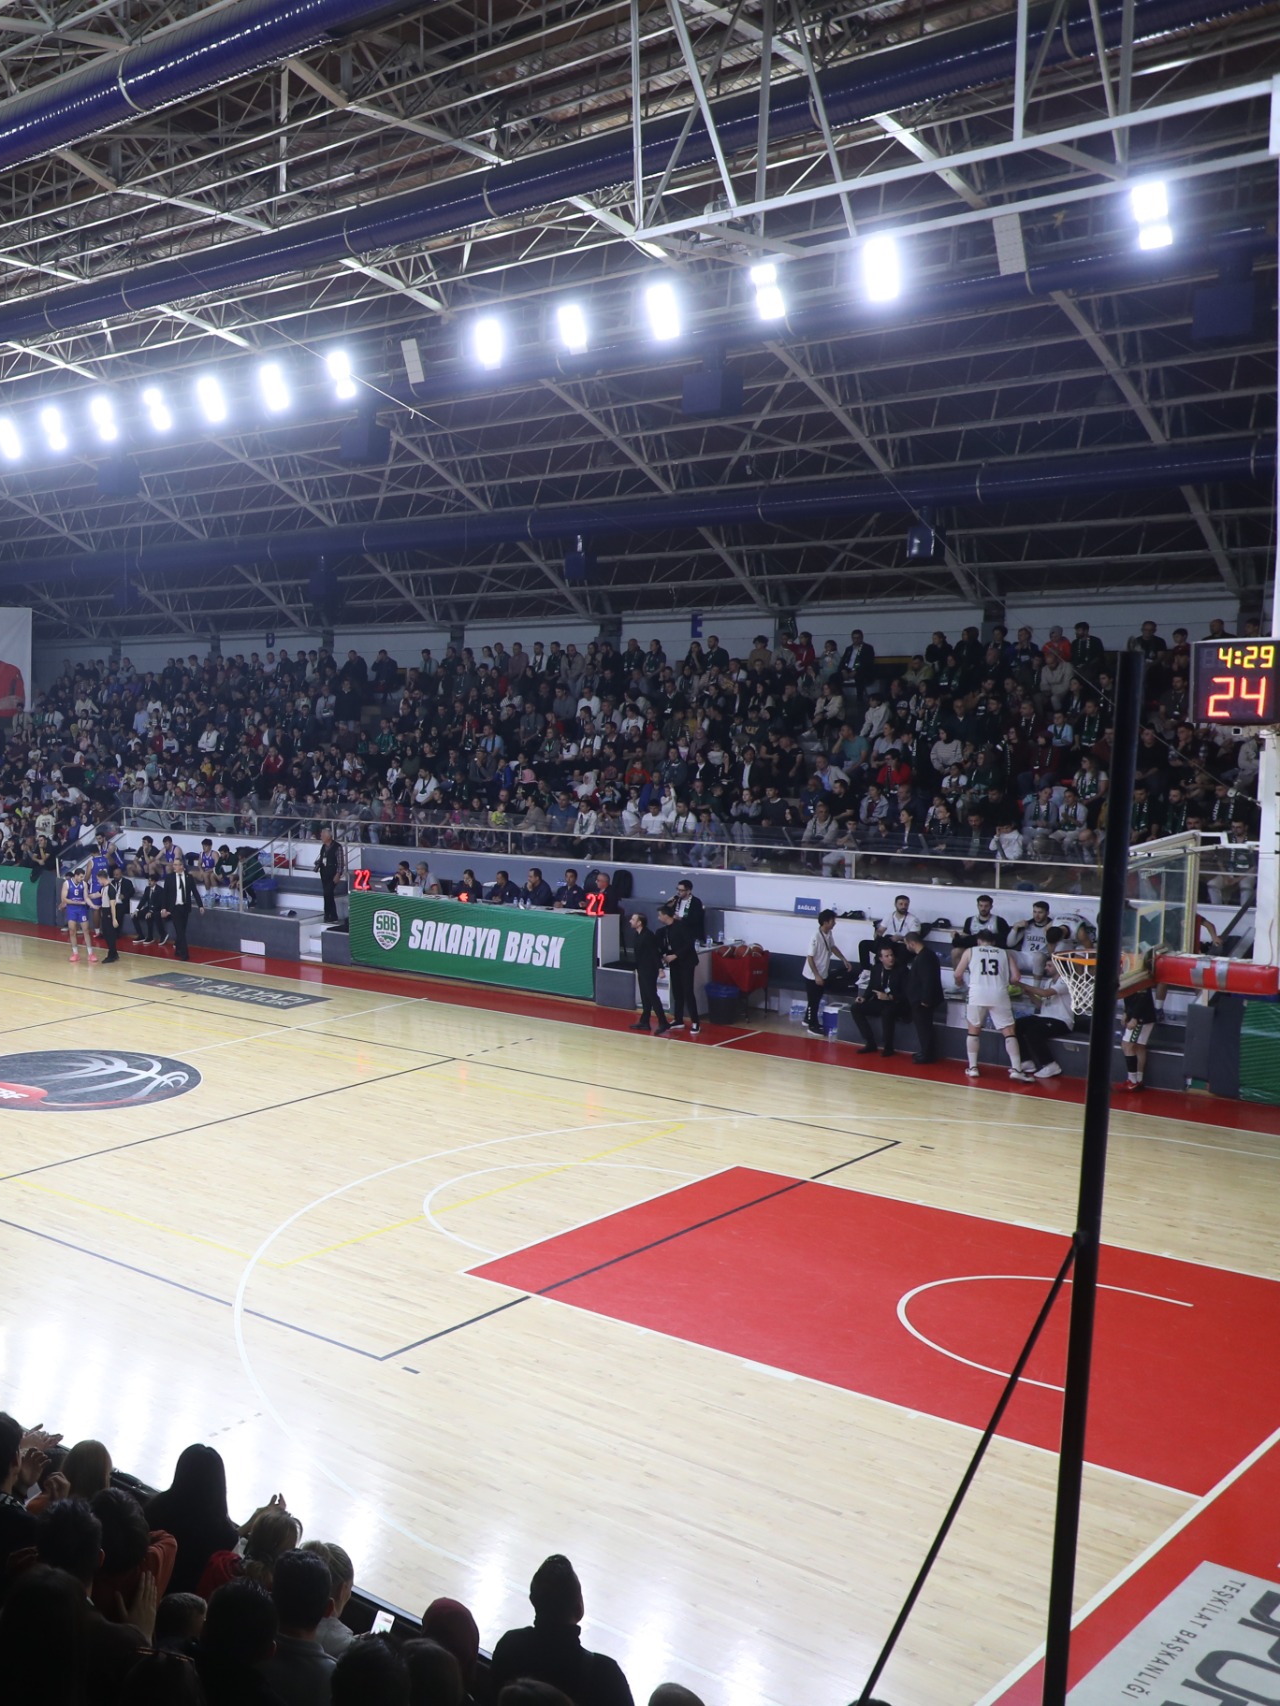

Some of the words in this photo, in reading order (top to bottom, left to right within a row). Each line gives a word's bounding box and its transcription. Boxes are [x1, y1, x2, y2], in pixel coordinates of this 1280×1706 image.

[1218, 646, 1275, 669] 4:29
[1207, 676, 1266, 717] 24
[353, 869, 371, 890] 22
[585, 892, 605, 916] 22
[376, 914, 398, 932] SBB
[408, 918, 501, 960] SAKARYA
[503, 930, 566, 969] BBSK
[1030, 943, 1040, 951] 24
[980, 958, 999, 975] 13
[208, 984, 312, 1006] ALTYAPI
[1190, 1580, 1247, 1629] TEŞKİLAT
[1121, 1629, 1198, 1699] BAŞKANLIĞI
